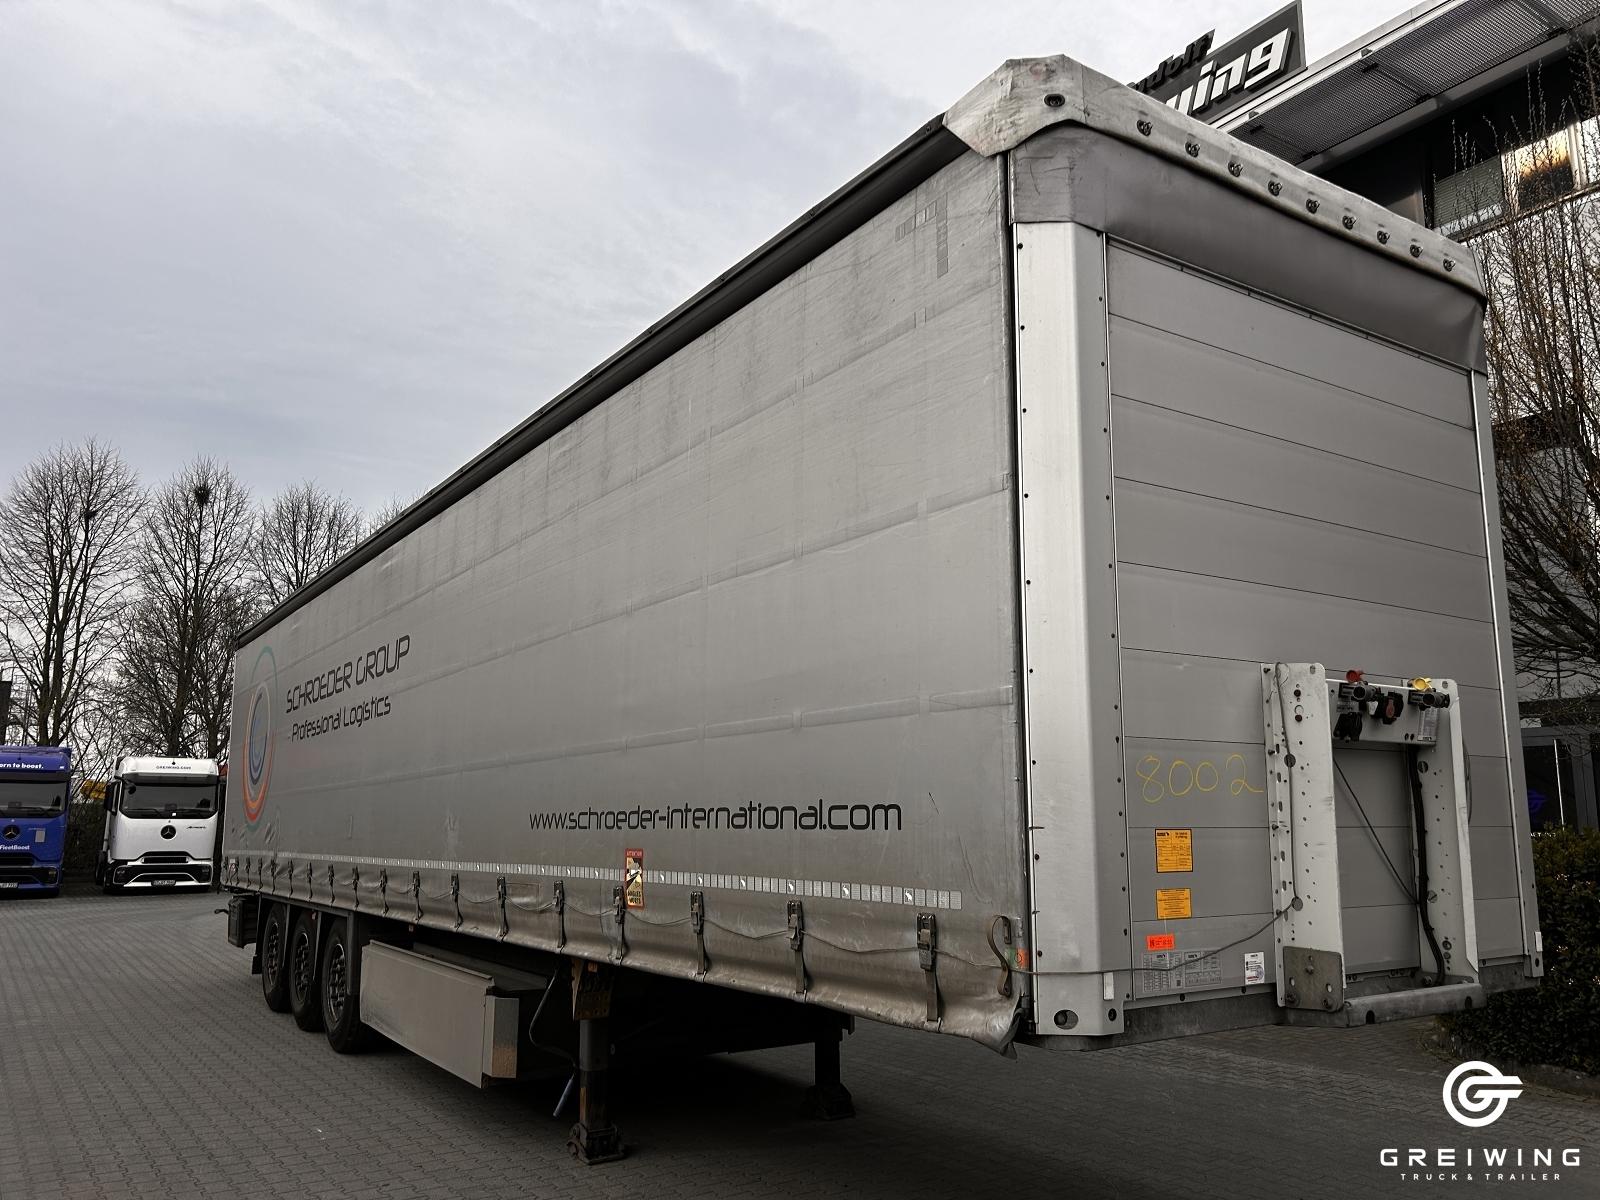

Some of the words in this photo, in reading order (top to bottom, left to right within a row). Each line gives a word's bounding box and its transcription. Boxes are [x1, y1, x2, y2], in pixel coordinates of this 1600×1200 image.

[286, 662, 353, 714] SCHROEDER
[356, 635, 410, 686] GROUP
[292, 707, 342, 742] Professional
[344, 695, 391, 728] Logistics
[1136, 754, 1265, 804] 8002
[529, 799, 902, 831] www.schroeder-international.com
